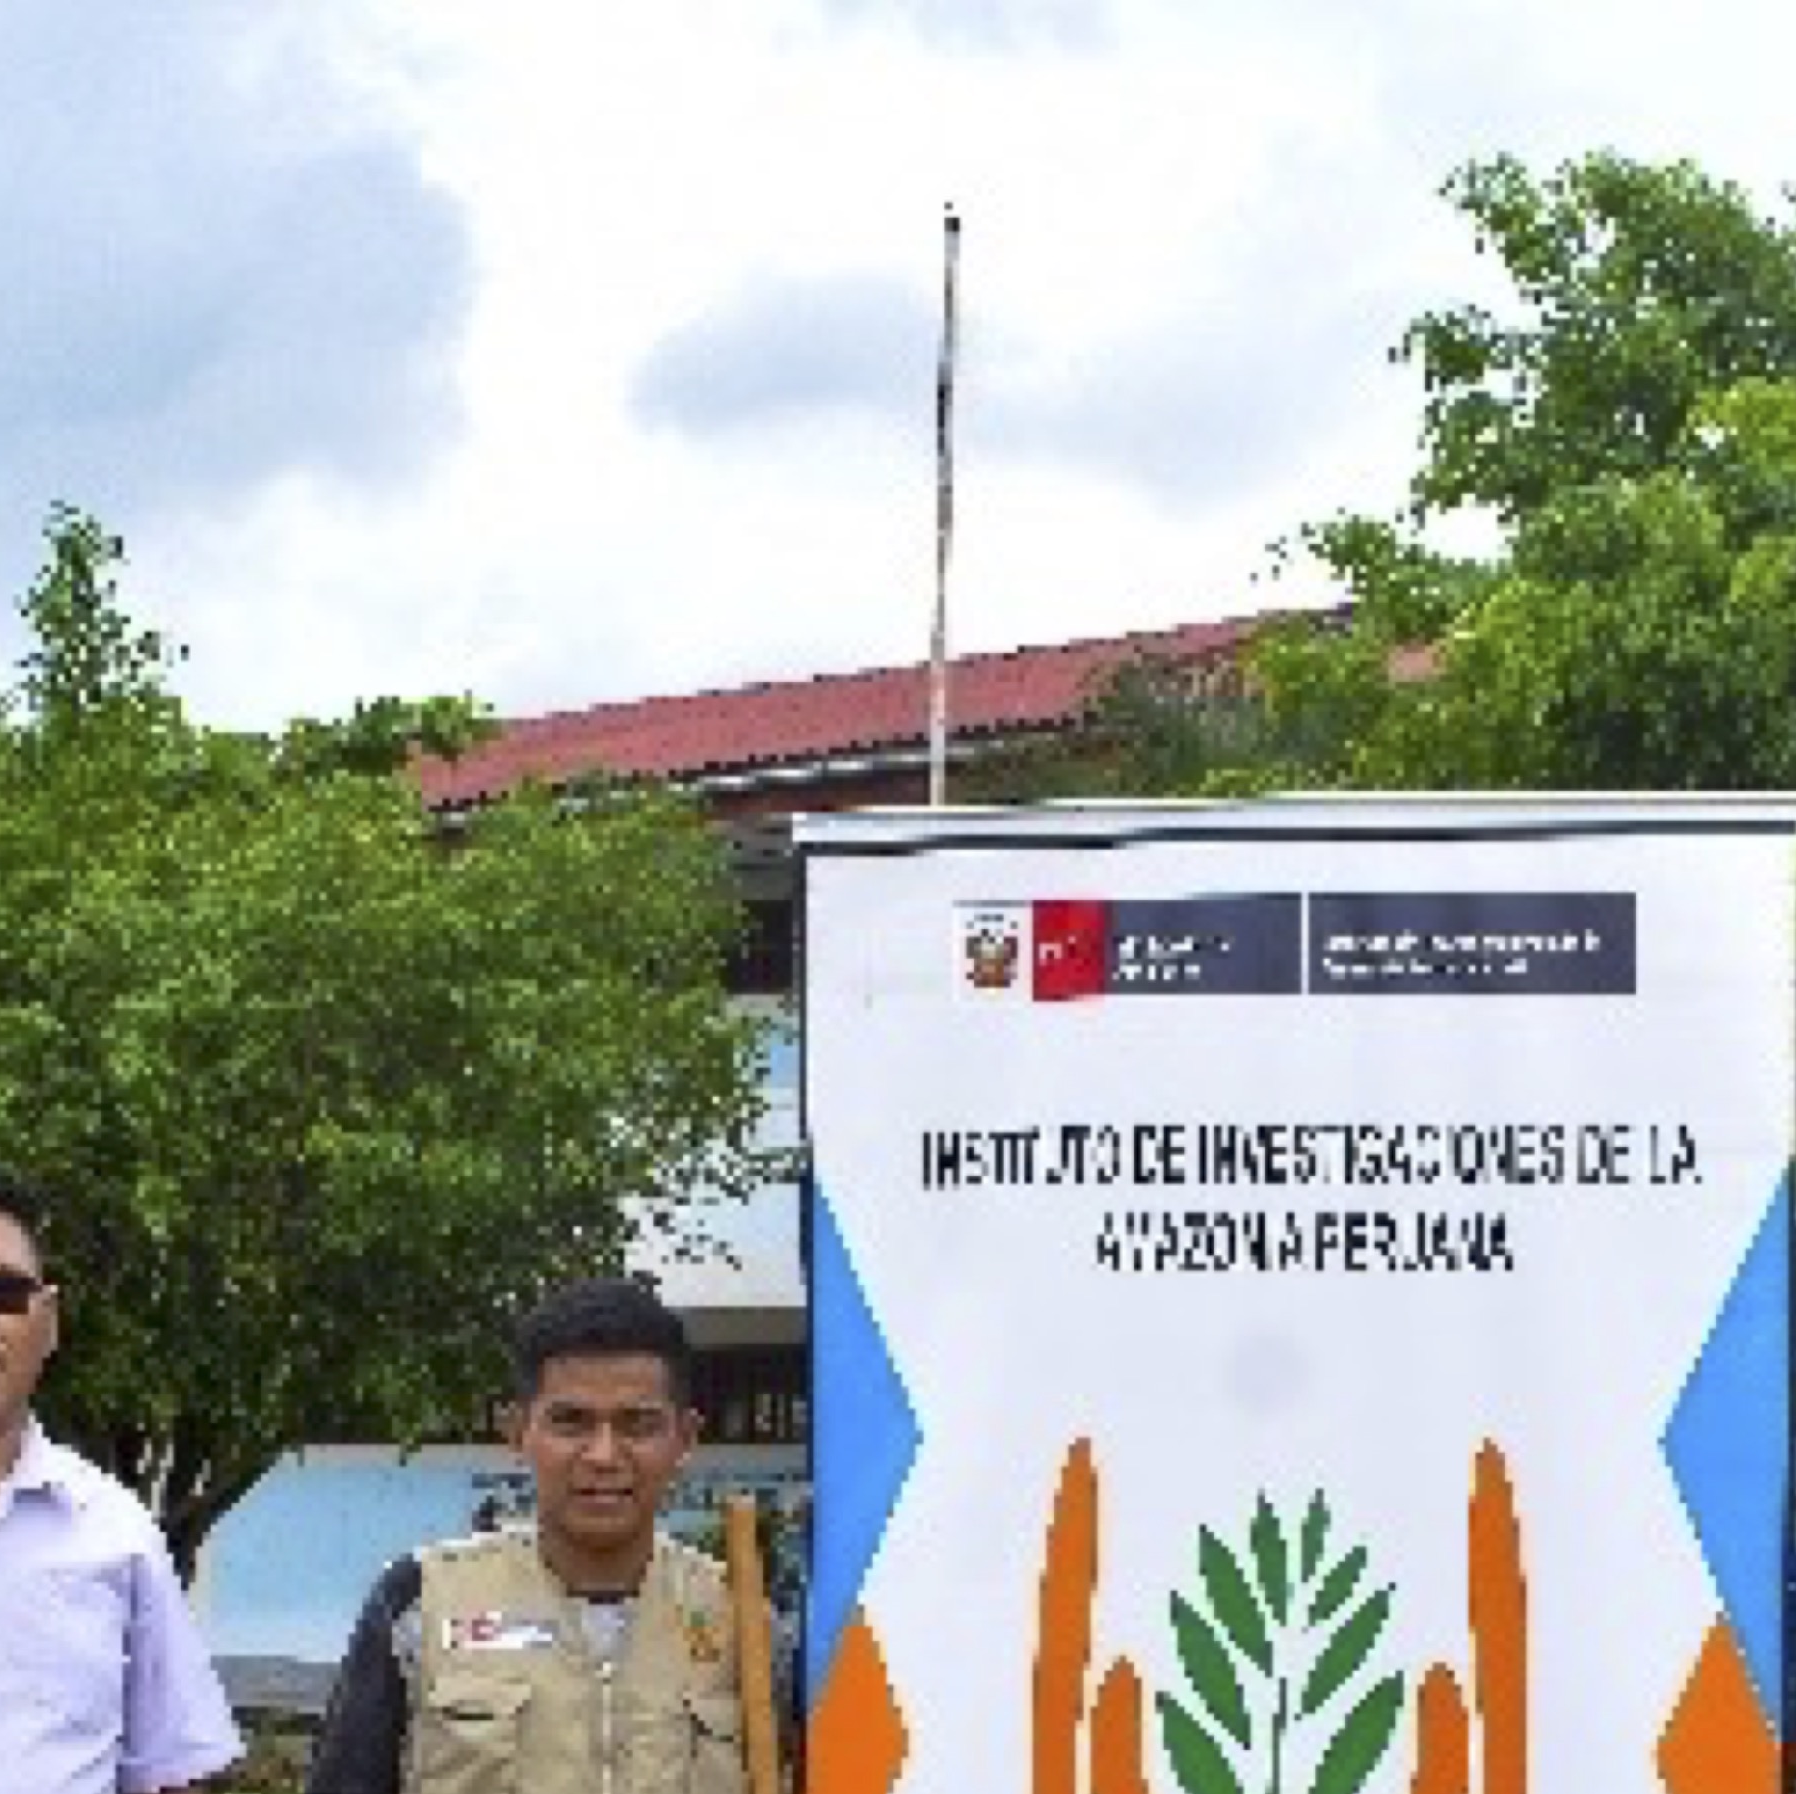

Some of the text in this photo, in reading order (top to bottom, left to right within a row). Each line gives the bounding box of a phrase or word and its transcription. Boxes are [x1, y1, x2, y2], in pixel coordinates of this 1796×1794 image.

[921, 1123, 1703, 1191] INSTITUTO DE INVESTIGACIONES DE LA
[1313, 1210, 1515, 1273] PERUANA
